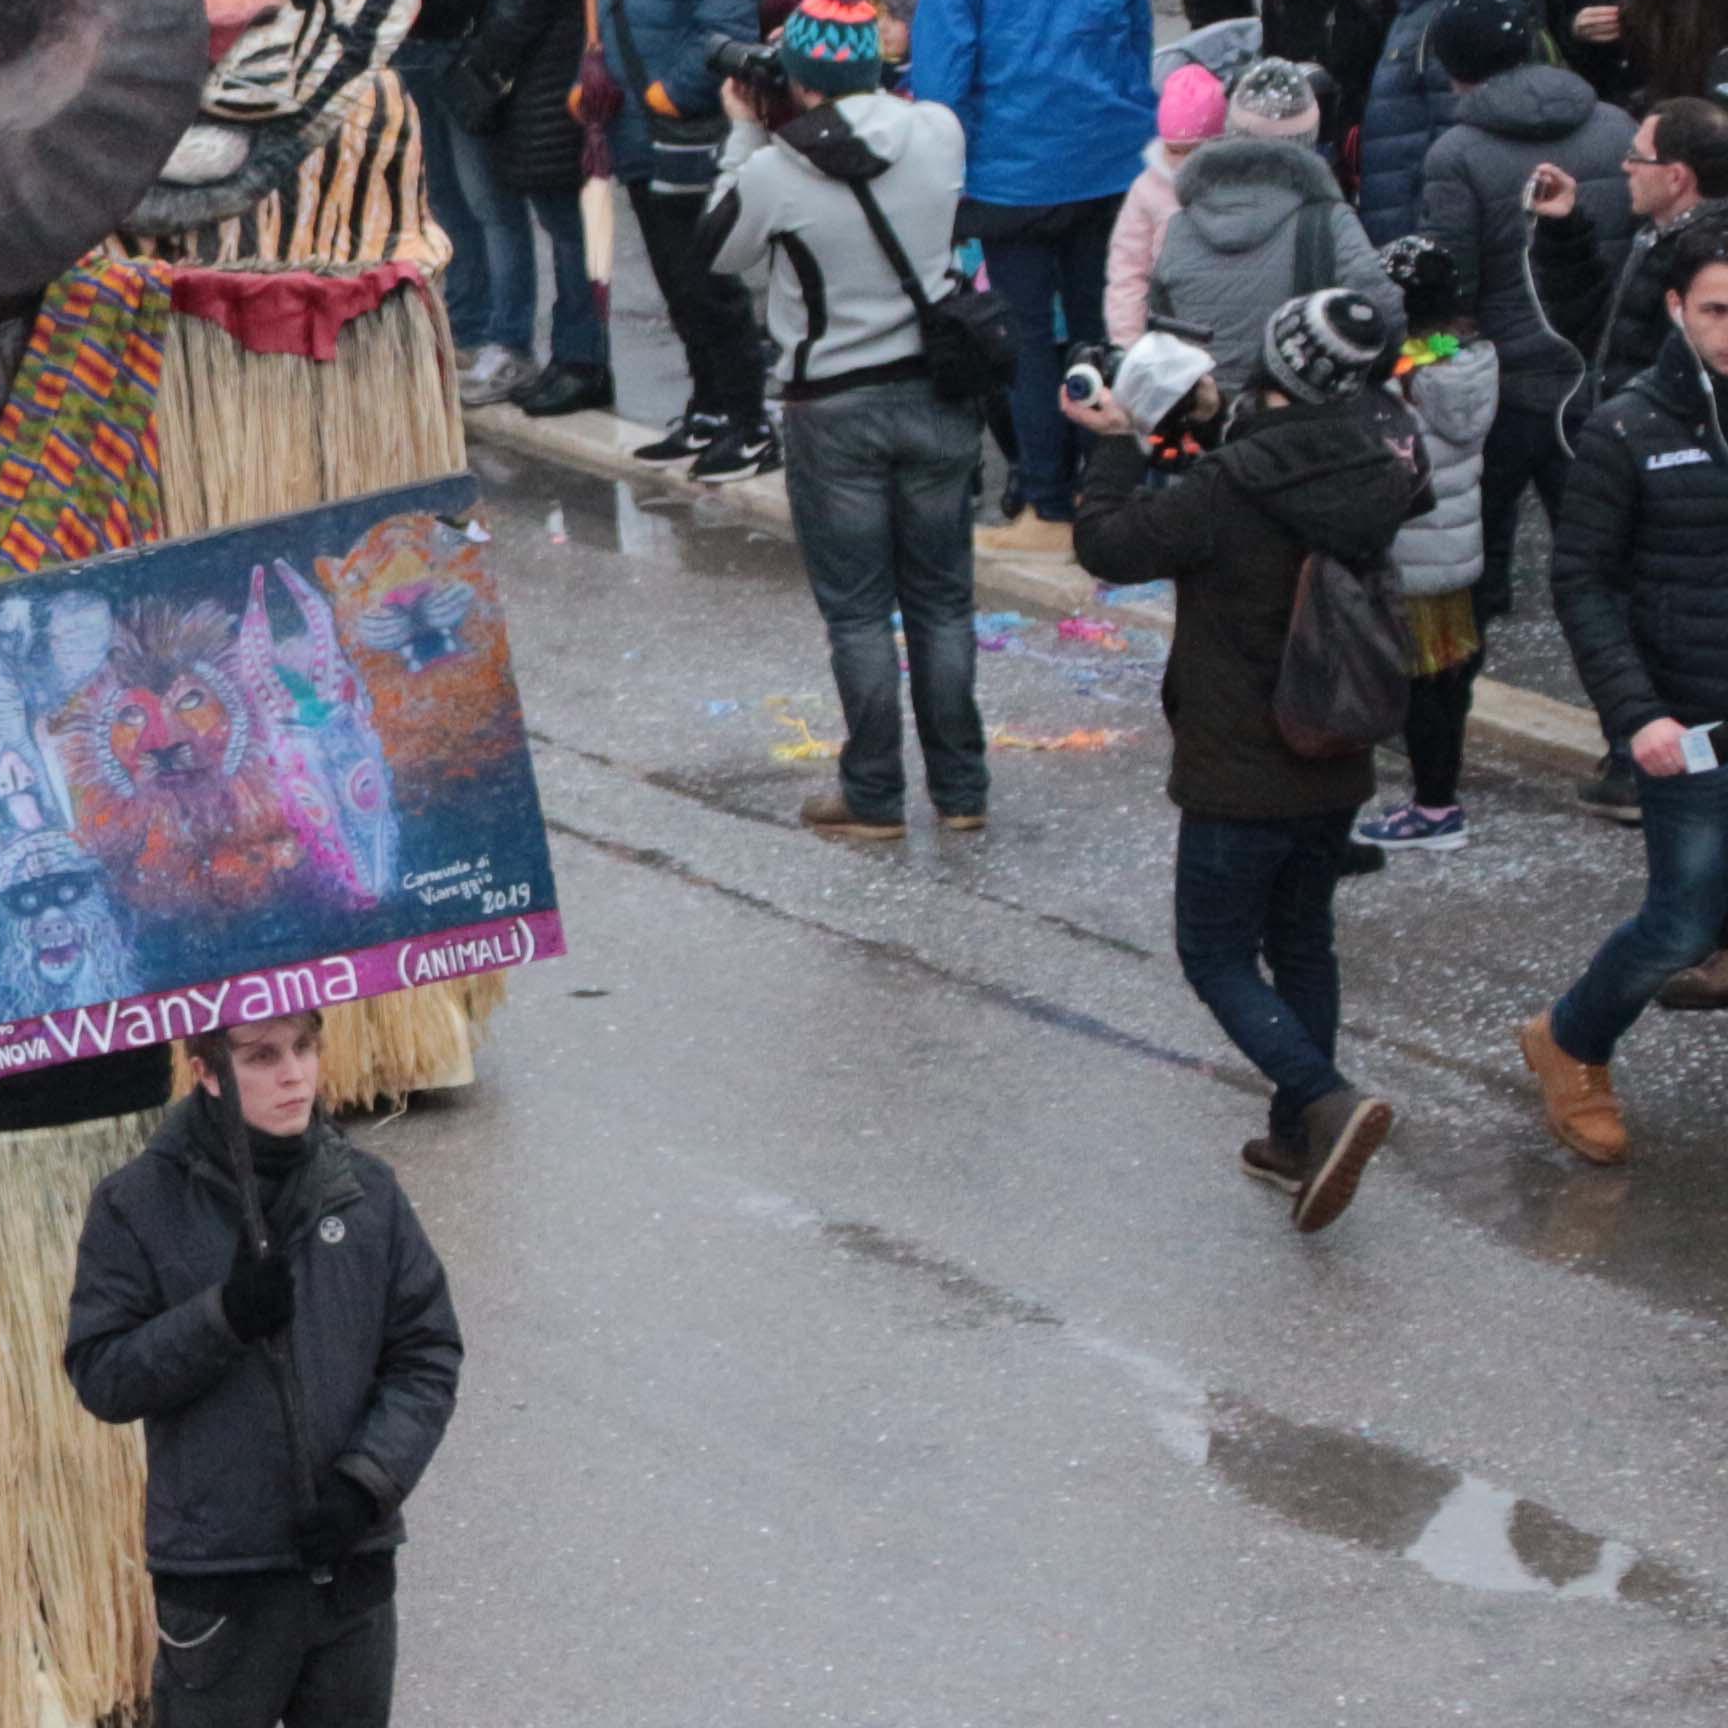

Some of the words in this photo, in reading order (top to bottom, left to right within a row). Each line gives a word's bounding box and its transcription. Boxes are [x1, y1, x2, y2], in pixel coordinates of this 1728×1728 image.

[403, 860, 471, 890] Carnevale
[418, 872, 493, 905] Viareggio
[481, 882, 531, 914] 2019
[42, 955, 359, 1058] Wanyama
